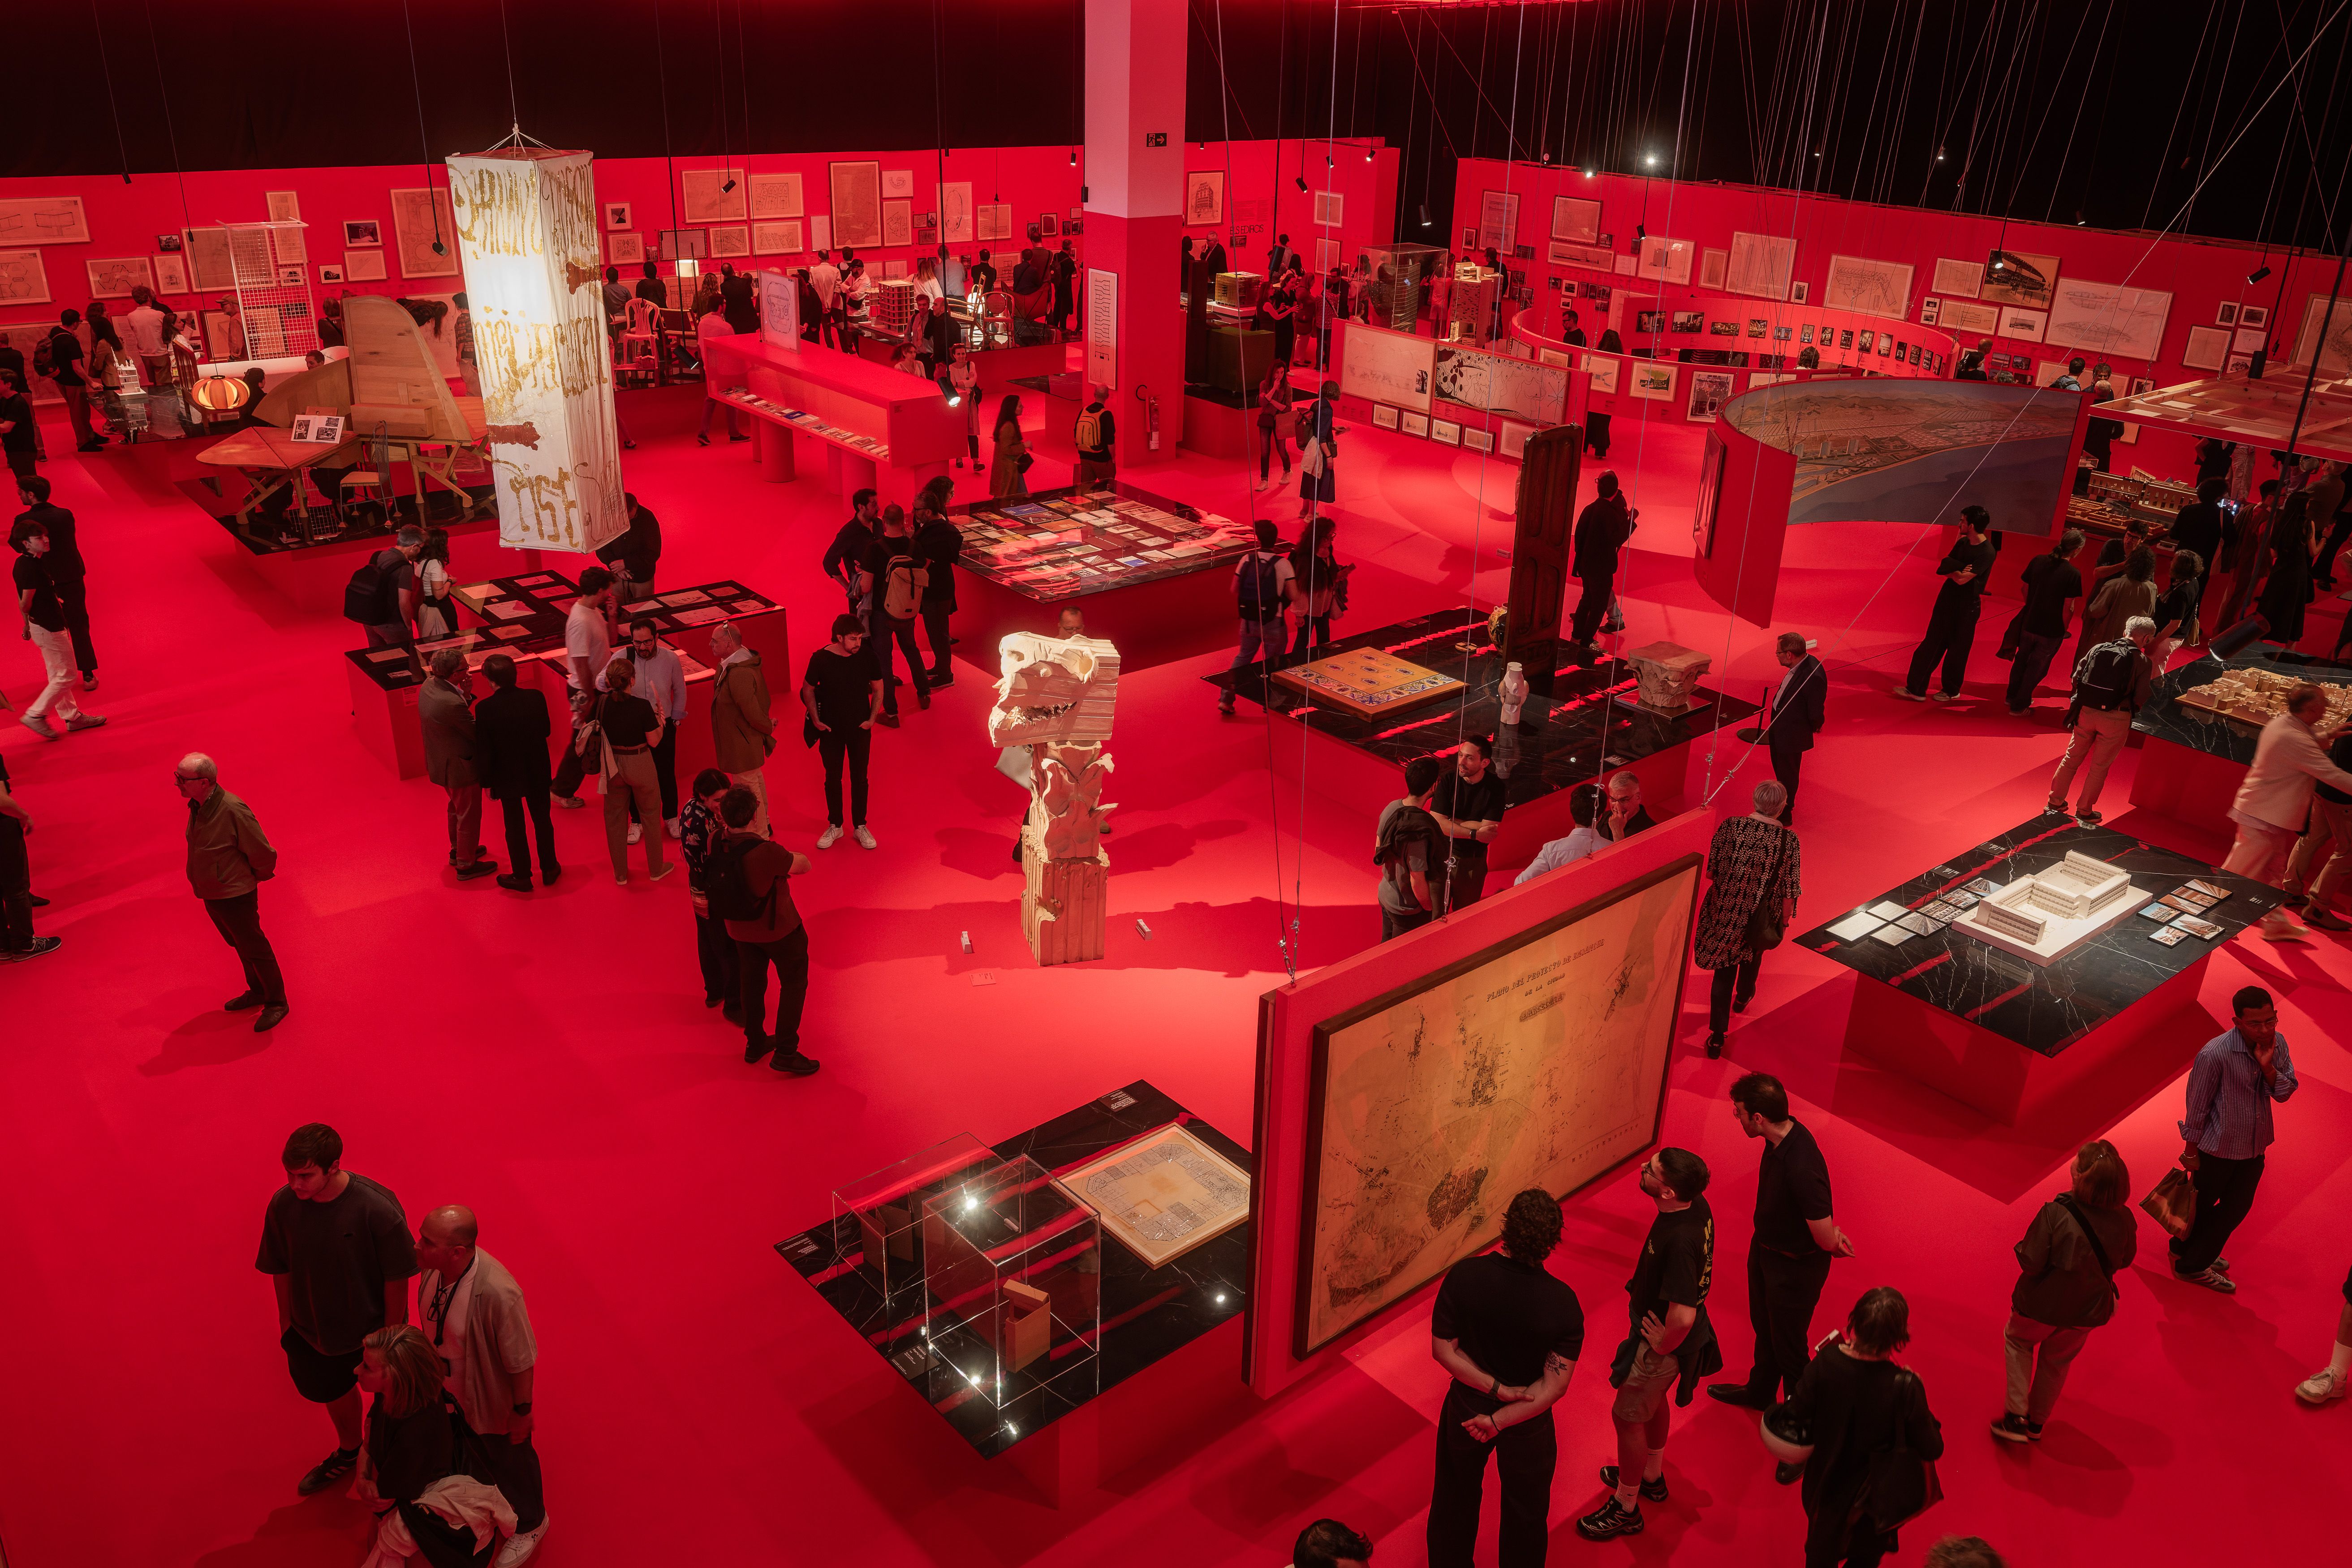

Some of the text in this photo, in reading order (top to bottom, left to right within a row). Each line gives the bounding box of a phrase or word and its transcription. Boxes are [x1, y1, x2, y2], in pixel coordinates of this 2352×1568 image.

[1230, 224, 1264, 235] ELS EDIFICIS
[1486, 985, 1509, 1002] PLANO
[1511, 978, 1525, 991] DEL
[1527, 960, 1561, 982] PROYECTO
[1562, 955, 1571, 965] DE
[1572, 939, 1605, 961] ENSANCHE
[1547, 973, 1566, 986] CIUDAD
